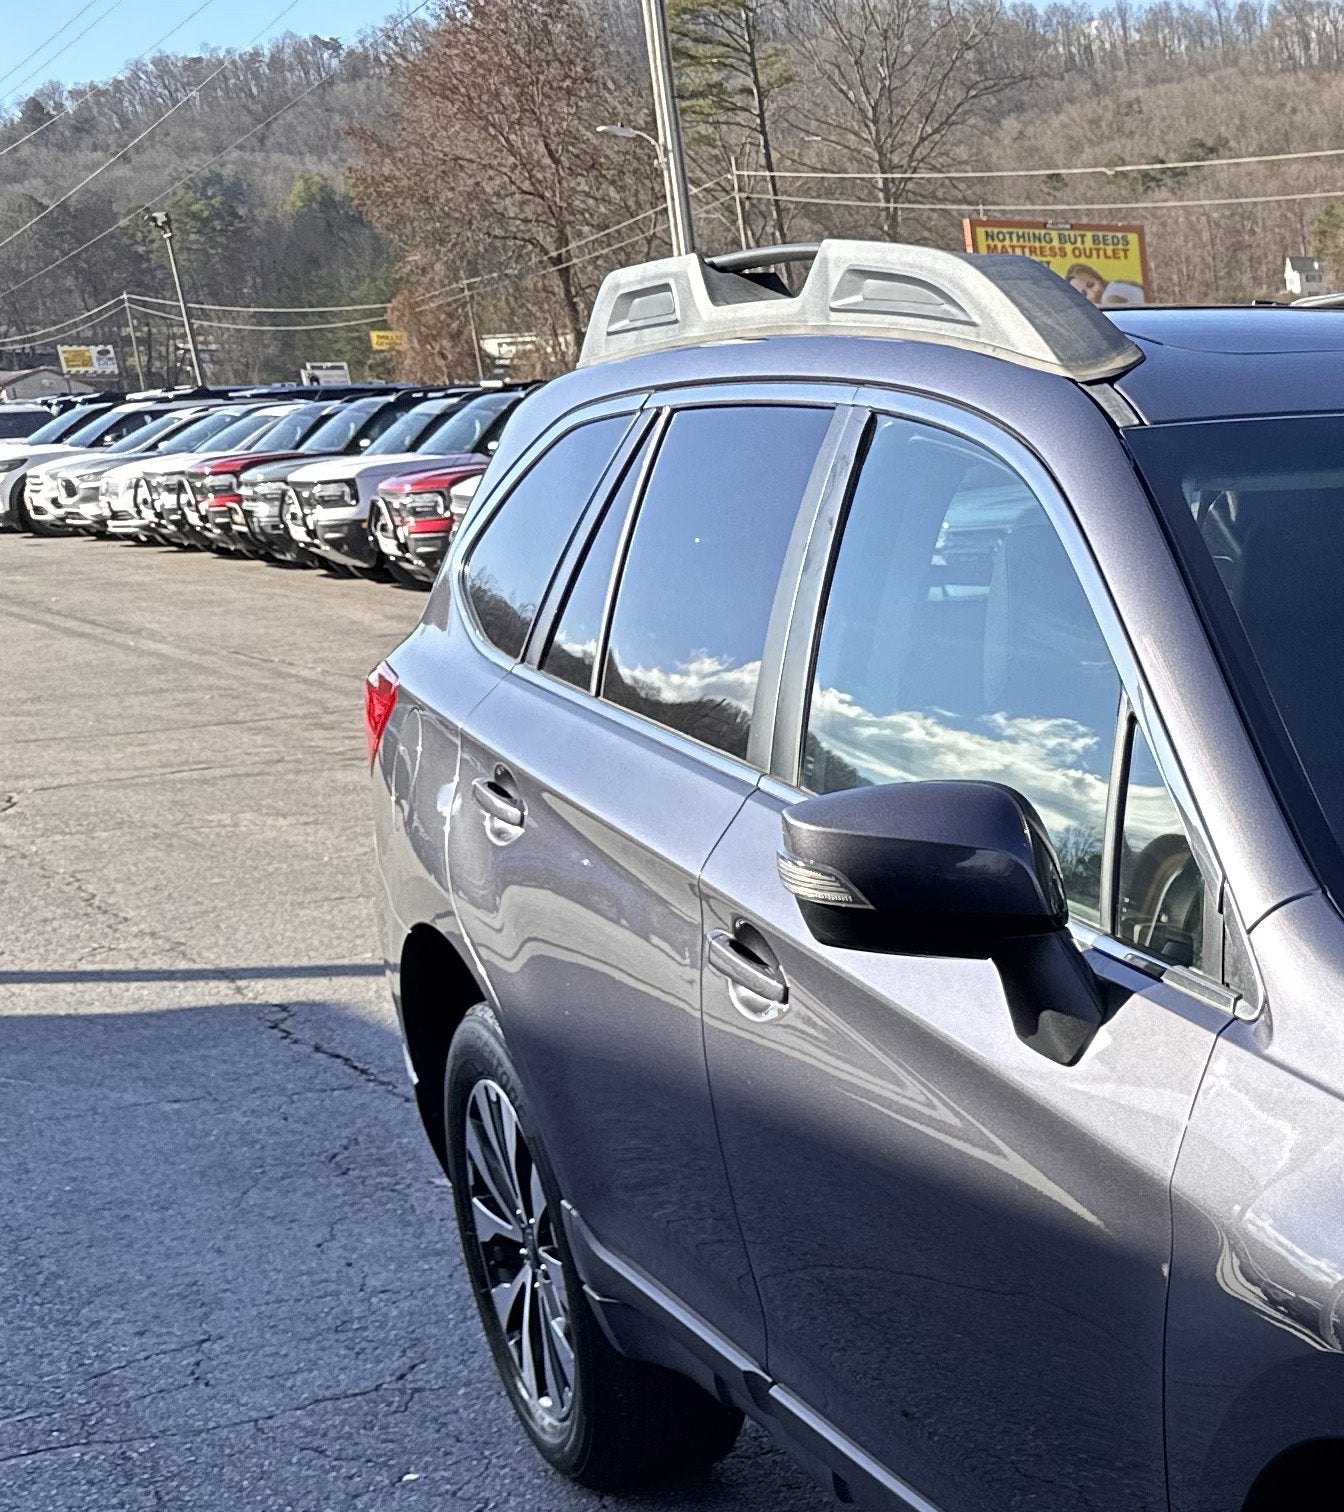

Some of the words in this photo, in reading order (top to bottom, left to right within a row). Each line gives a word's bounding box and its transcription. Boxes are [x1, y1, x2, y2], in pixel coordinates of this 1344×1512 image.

[984, 230, 1053, 244] NOTHING
[1058, 232, 1087, 246] BUT
[1091, 234, 1130, 247] BEDS
[986, 243, 1068, 258] MATTRESS
[1072, 246, 1130, 260] OUTLET
